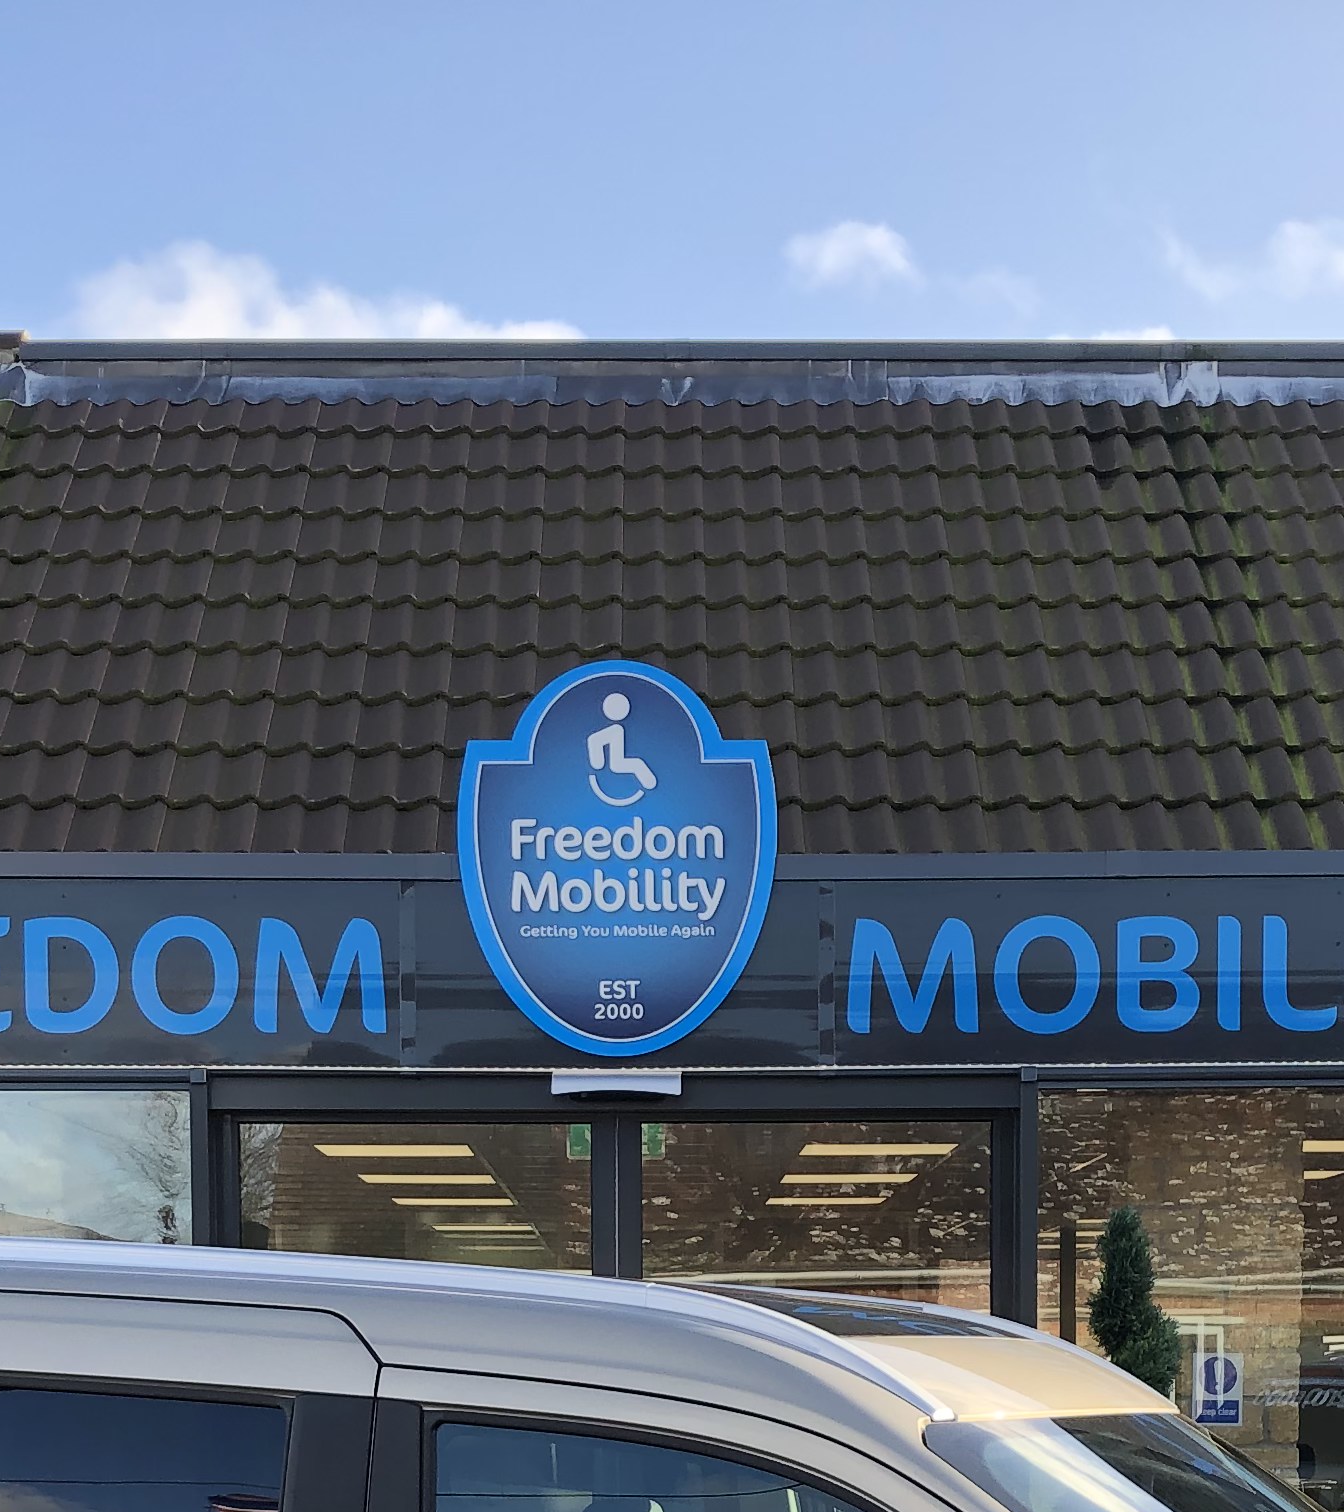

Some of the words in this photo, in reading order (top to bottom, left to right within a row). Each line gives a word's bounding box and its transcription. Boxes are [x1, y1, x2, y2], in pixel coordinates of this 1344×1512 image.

[511, 816, 724, 861] Freedom
[511, 867, 726, 921] Mobility
[519, 924, 578, 940] Getting
[581, 925, 610, 938] You
[613, 924, 668, 938] Mobile
[670, 924, 716, 940] Again
[599, 980, 641, 1000] EST
[594, 1003, 644, 1020] 2000
